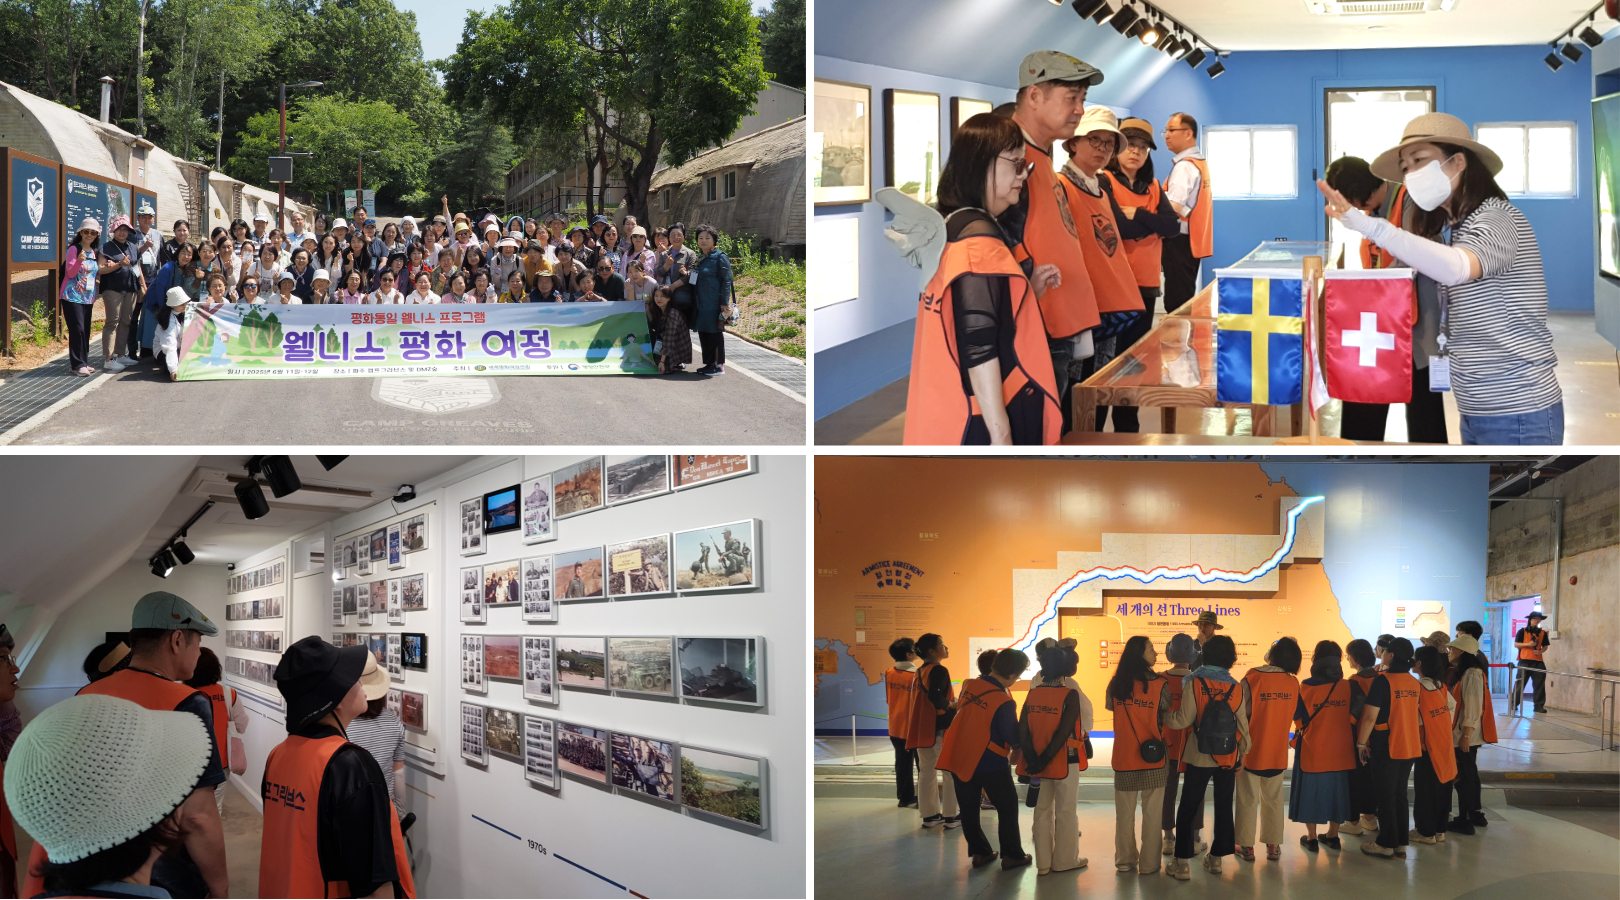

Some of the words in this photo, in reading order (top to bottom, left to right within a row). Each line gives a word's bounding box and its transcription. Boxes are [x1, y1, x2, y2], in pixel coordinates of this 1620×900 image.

[350, 312, 397, 325] 평화통일
[400, 311, 436, 325] 웰니스
[439, 311, 486, 324] 프로그램
[282, 331, 386, 362] 웰니스
[399, 329, 467, 361] 평화
[481, 329, 551, 359] 여정
[343, 420, 414, 428] CAMP
[421, 420, 533, 429] GREAVES
[861, 560, 891, 577] ARMISTICE
[892, 560, 926, 578] AGREEMENT
[1115, 602, 1128, 617] 세
[1129, 602, 1154, 617] 개의
[1156, 602, 1168, 617] 선
[1169, 602, 1205, 617] Three
[1259, 692, 1293, 702] 캠프그리브스
[527, 838, 547, 856] 1970s
